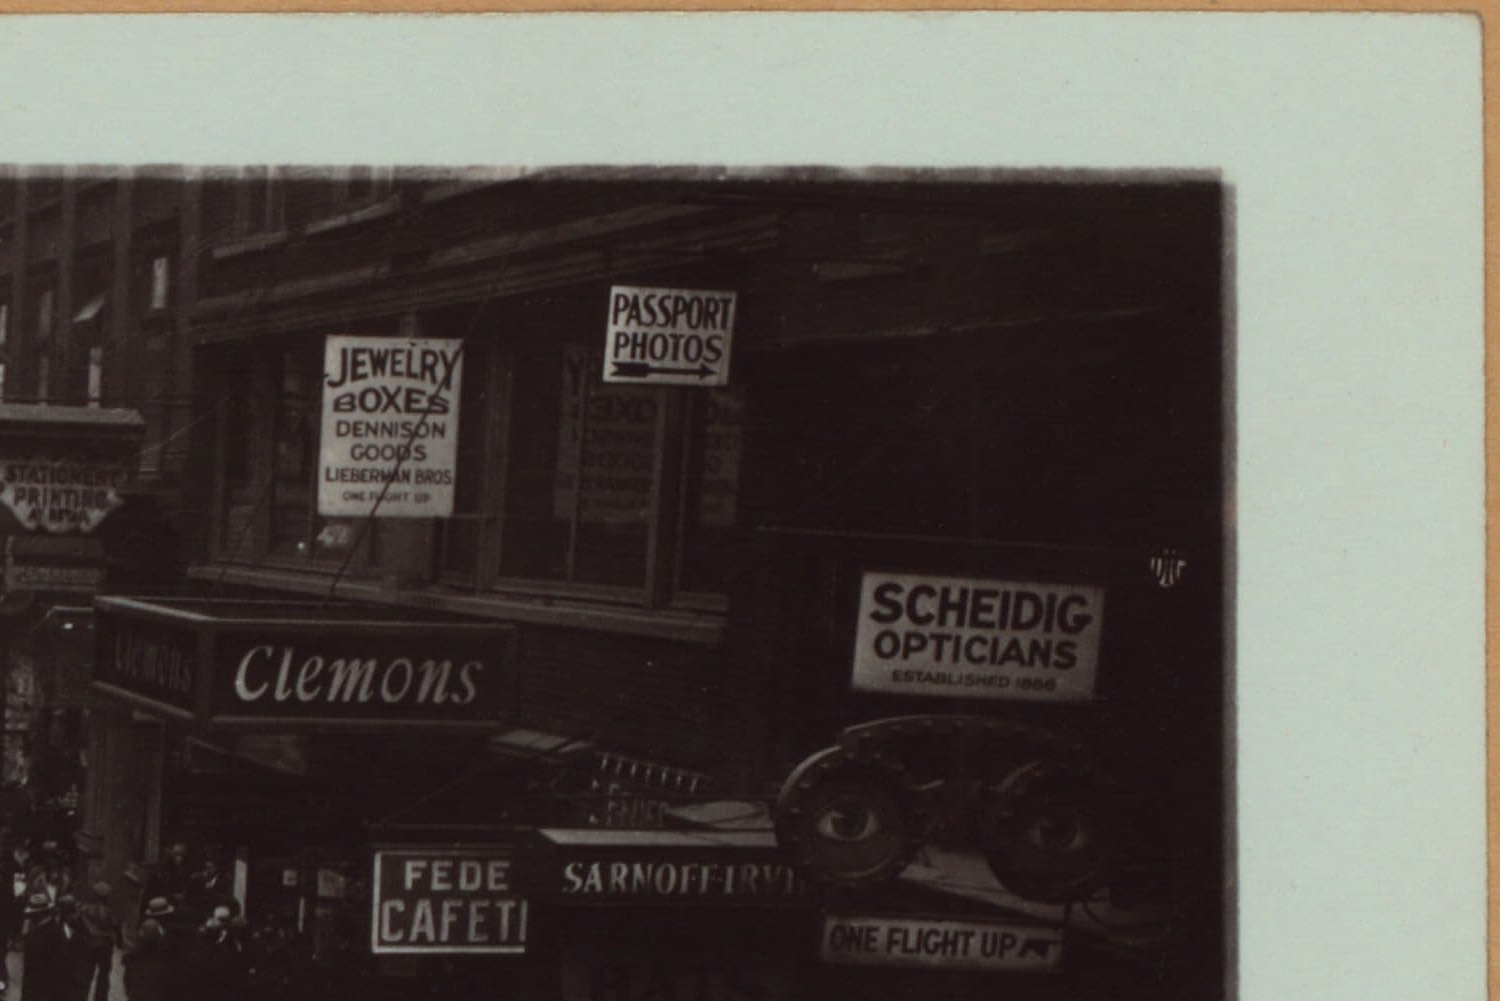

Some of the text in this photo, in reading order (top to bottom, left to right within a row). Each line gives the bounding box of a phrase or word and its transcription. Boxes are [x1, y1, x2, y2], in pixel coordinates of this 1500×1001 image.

[612, 292, 732, 329] PASSPORT
[613, 331, 723, 363] PHOTOS
[326, 347, 462, 390] JEWELRY
[332, 385, 450, 414] BOXES
[336, 420, 446, 438] DENNISON
[350, 443, 427, 461] GOODS
[325, 466, 452, 485] LIEBERMAN BROS
[15, 486, 108, 508] PRINTING
[342, 491, 431, 503] ONE FLIGHT UP
[870, 582, 1092, 634] SCHEIDIG
[873, 629, 1078, 669] OPTICIANS
[235, 645, 484, 704] Clemons
[892, 670, 1010, 690] ESTABLISHED
[404, 860, 511, 892] FEDE
[830, 924, 1017, 958] ONE FLIGHT UP
